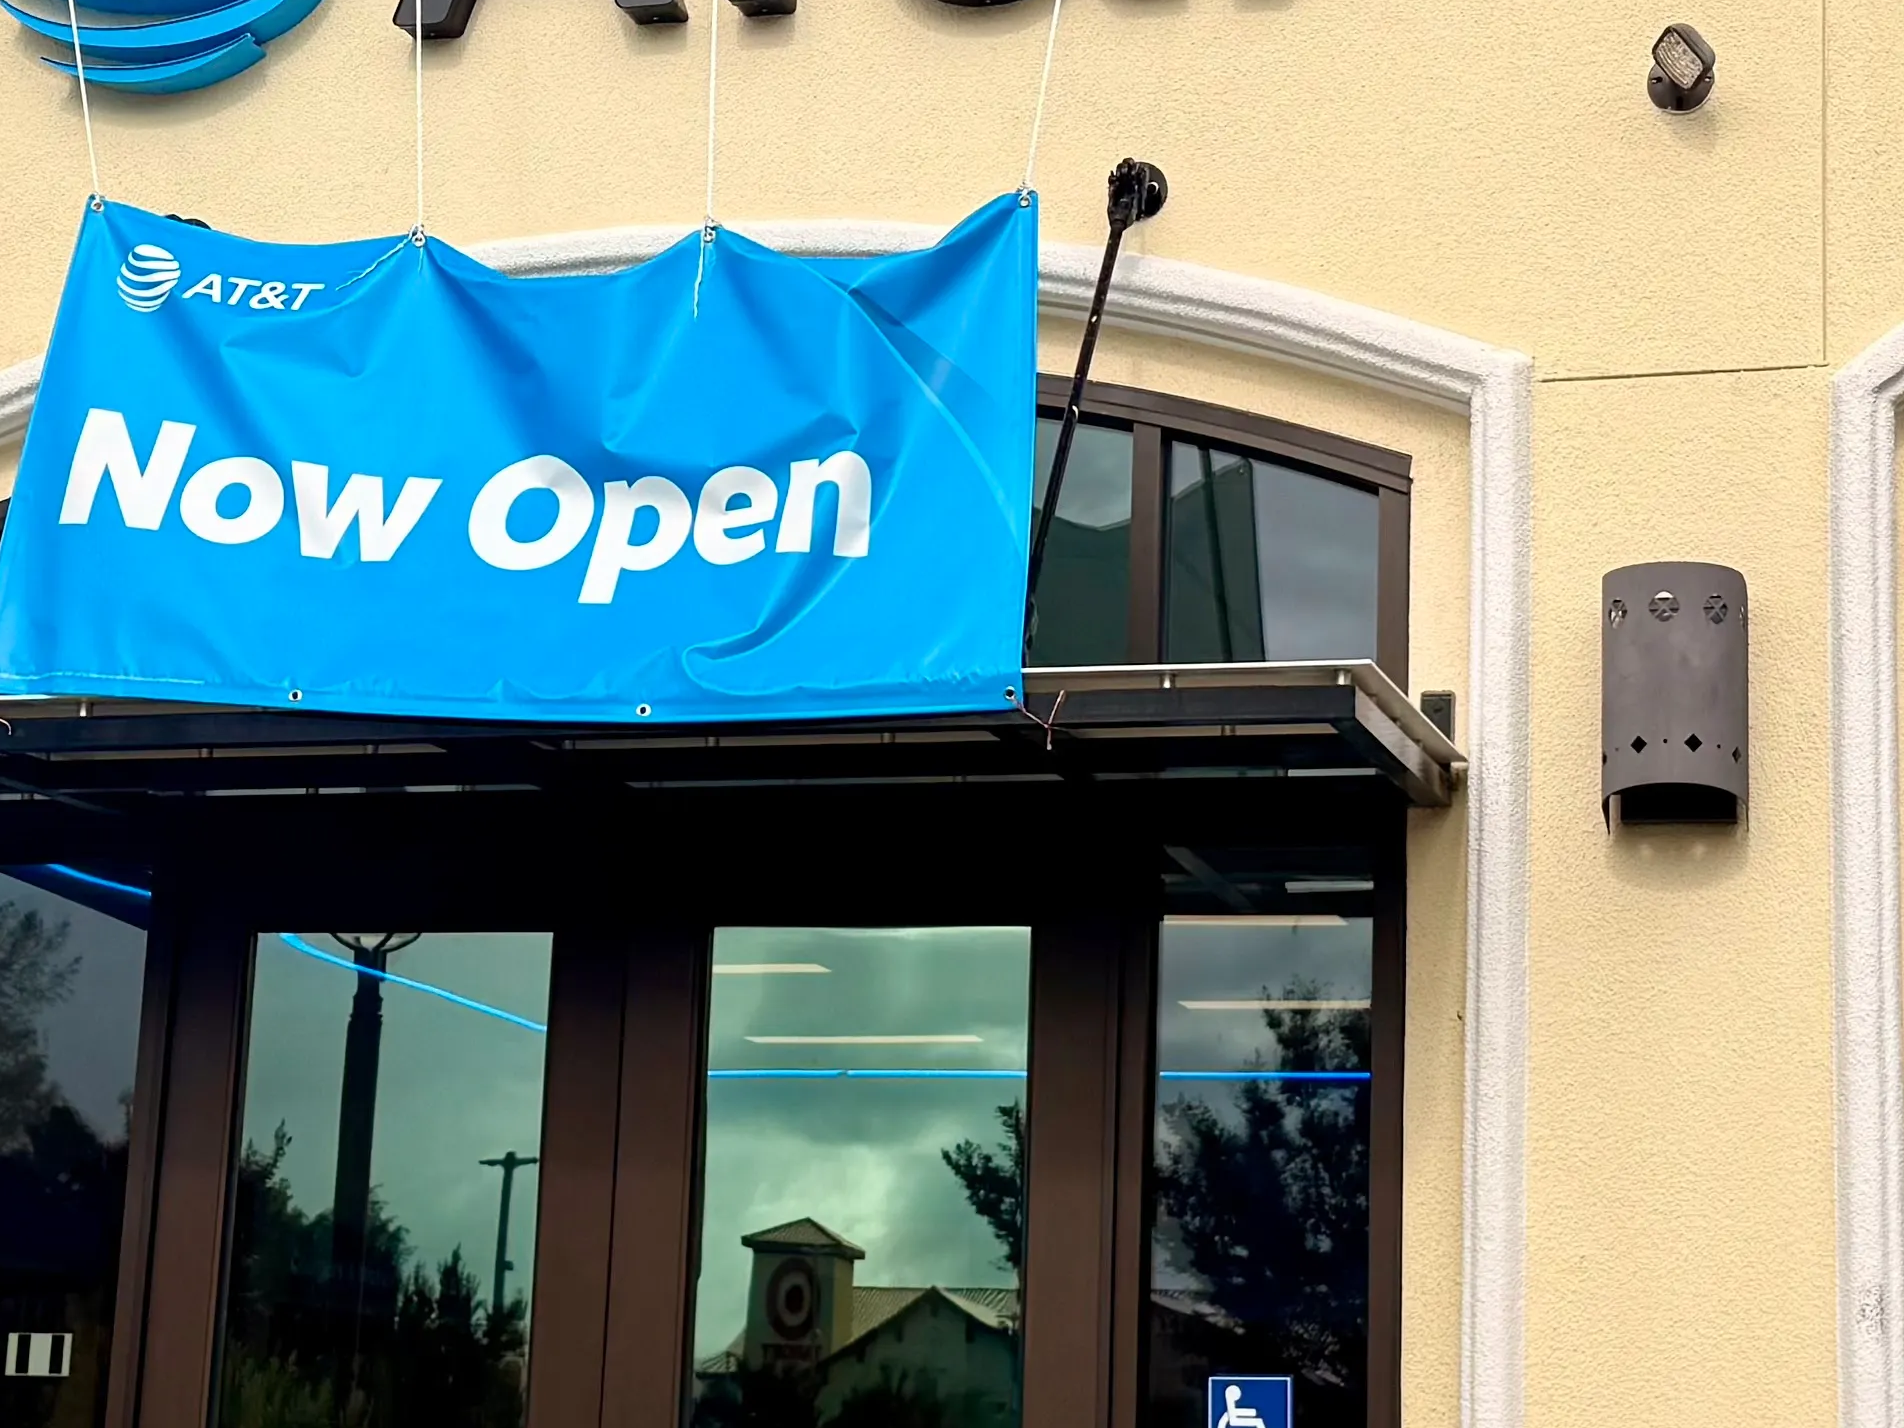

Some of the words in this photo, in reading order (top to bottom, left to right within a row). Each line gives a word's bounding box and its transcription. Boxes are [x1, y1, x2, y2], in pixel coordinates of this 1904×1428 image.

[182, 273, 325, 310] AT&T
[58, 407, 443, 563] Now
[467, 449, 872, 604] Open
